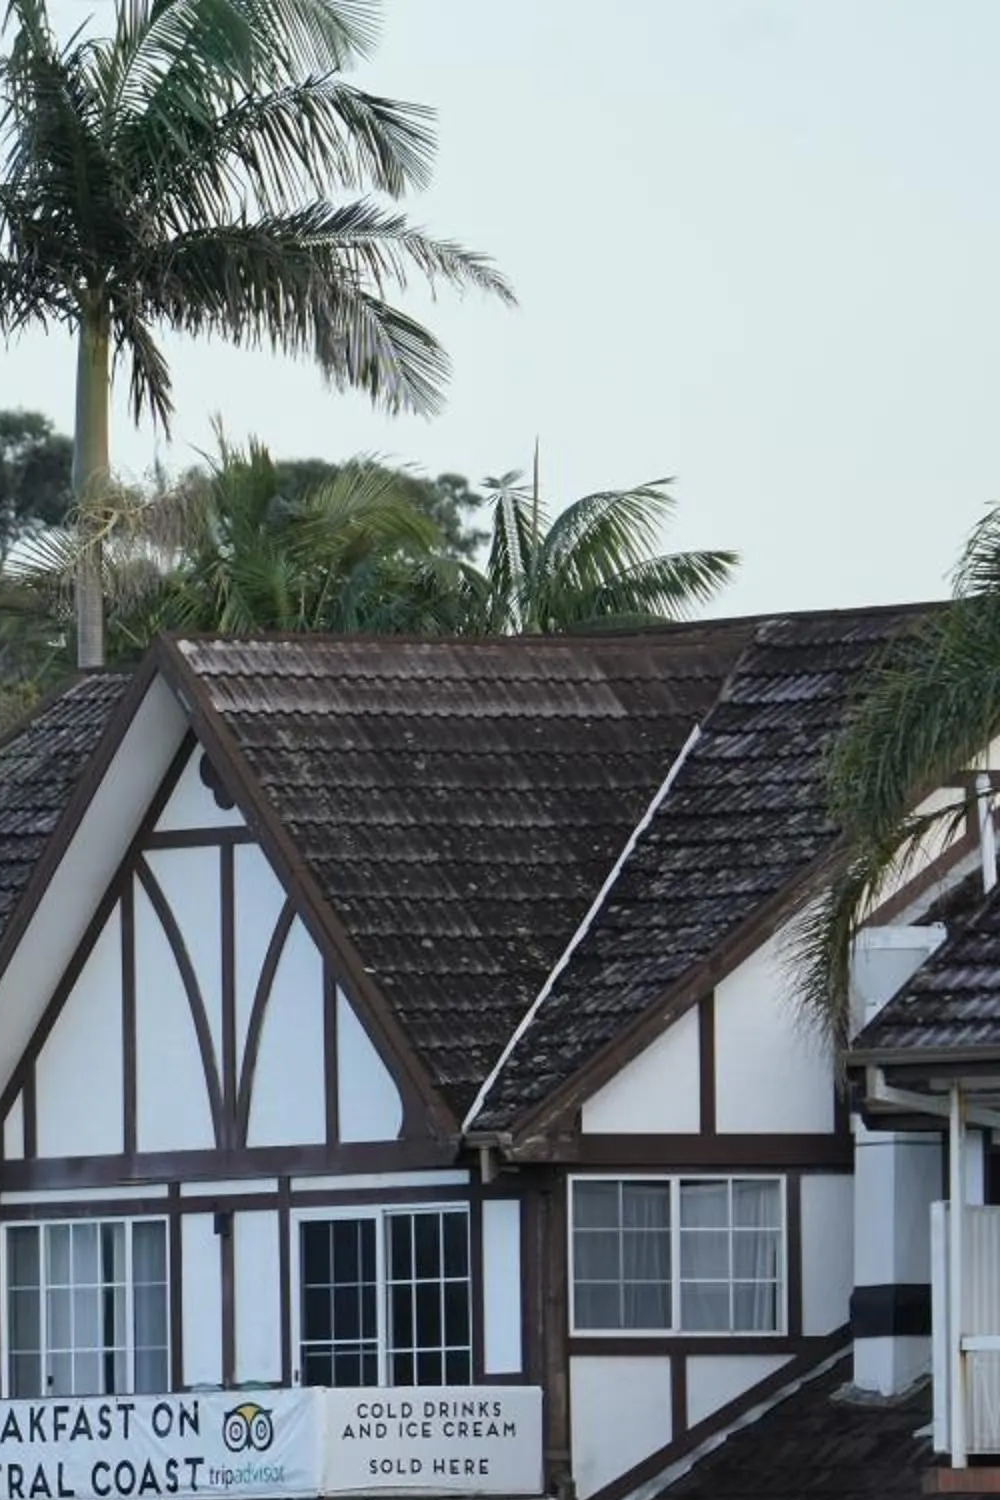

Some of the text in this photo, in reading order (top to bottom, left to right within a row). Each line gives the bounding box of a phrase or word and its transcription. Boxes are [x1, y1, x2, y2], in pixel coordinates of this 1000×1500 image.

[151, 1400, 200, 1438] ON
[357, 1401, 502, 1419] COLD DRINKS
[341, 1421, 517, 1440] AND ICE CREAM
[91, 1457, 205, 1496] COAST
[209, 1462, 285, 1489] tripadvisor
[369, 1459, 490, 1475] SOLD HERE
